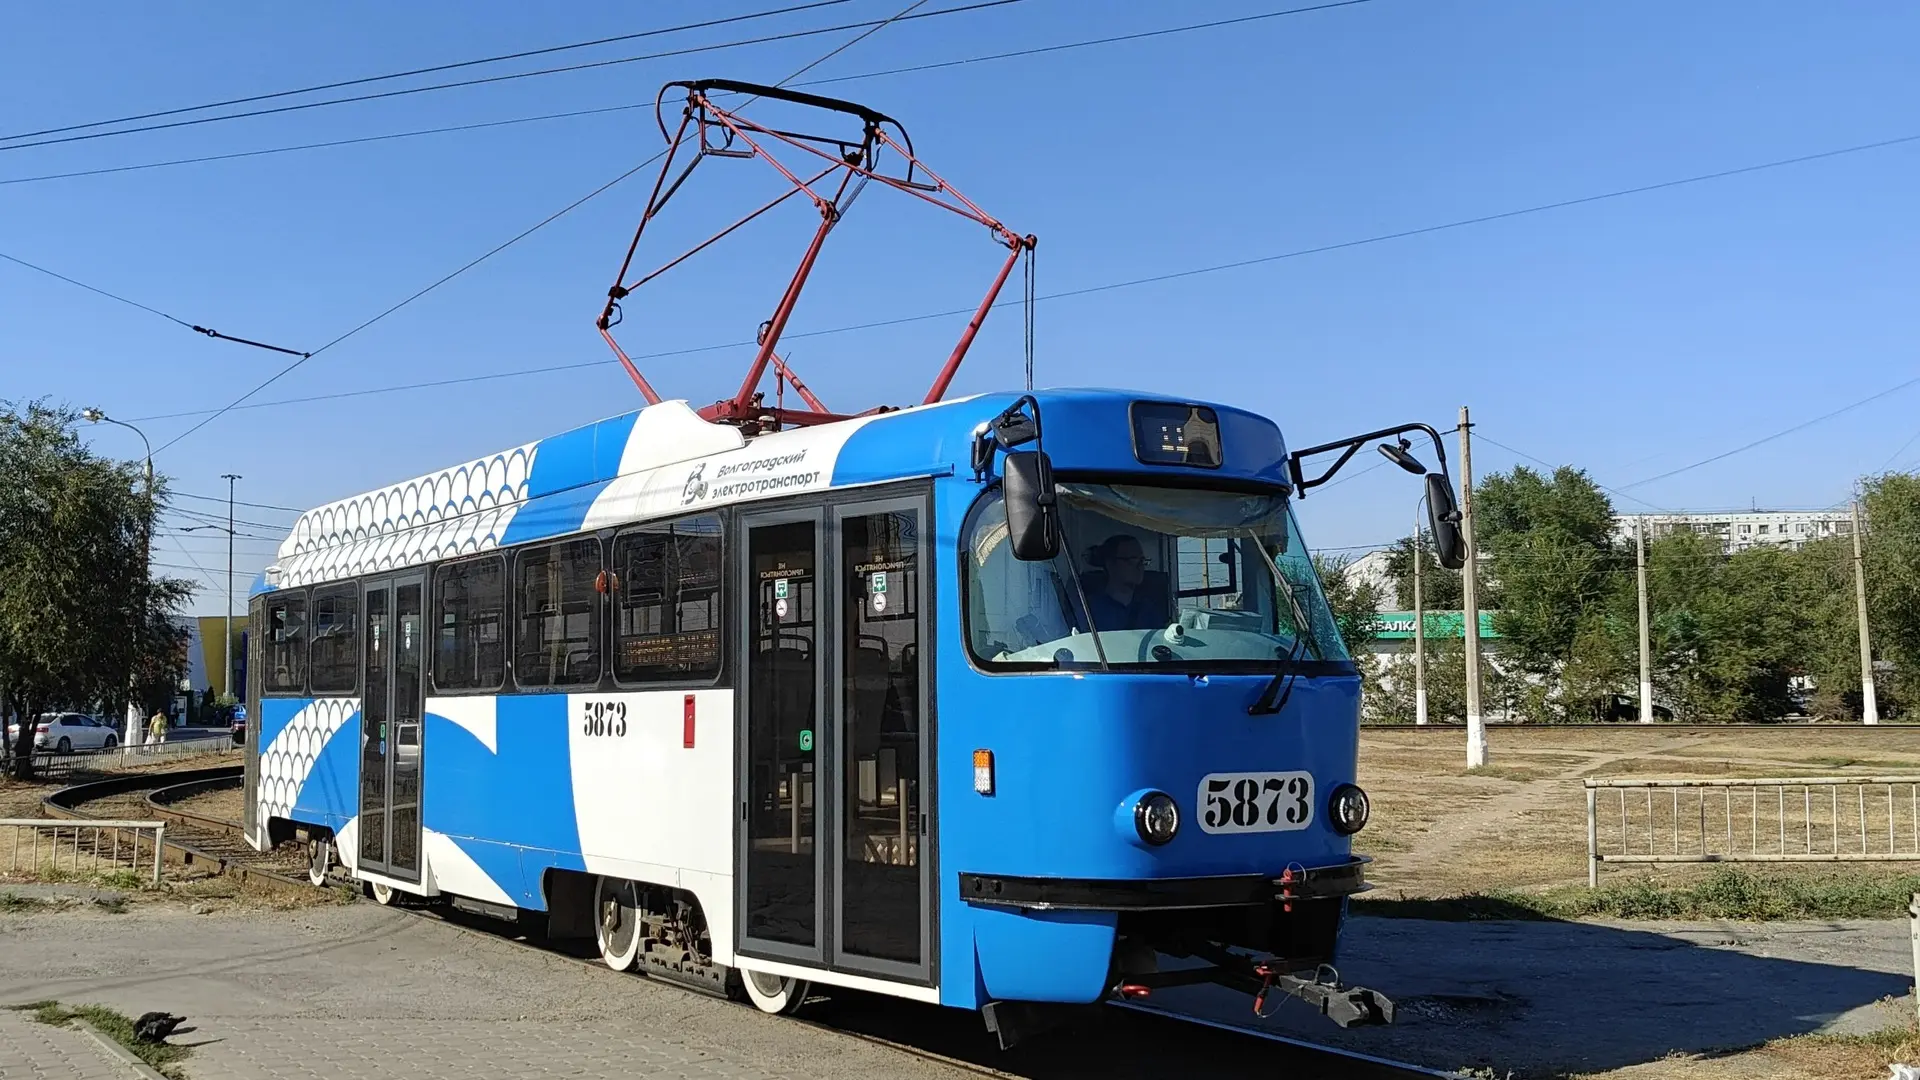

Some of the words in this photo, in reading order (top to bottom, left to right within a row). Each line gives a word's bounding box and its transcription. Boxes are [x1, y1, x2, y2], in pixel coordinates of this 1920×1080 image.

[717, 449, 808, 478] Волгоградский
[712, 471, 820, 499] электротранспорт
[584, 701, 627, 737] 5873
[1205, 777, 1309, 828] 5873
